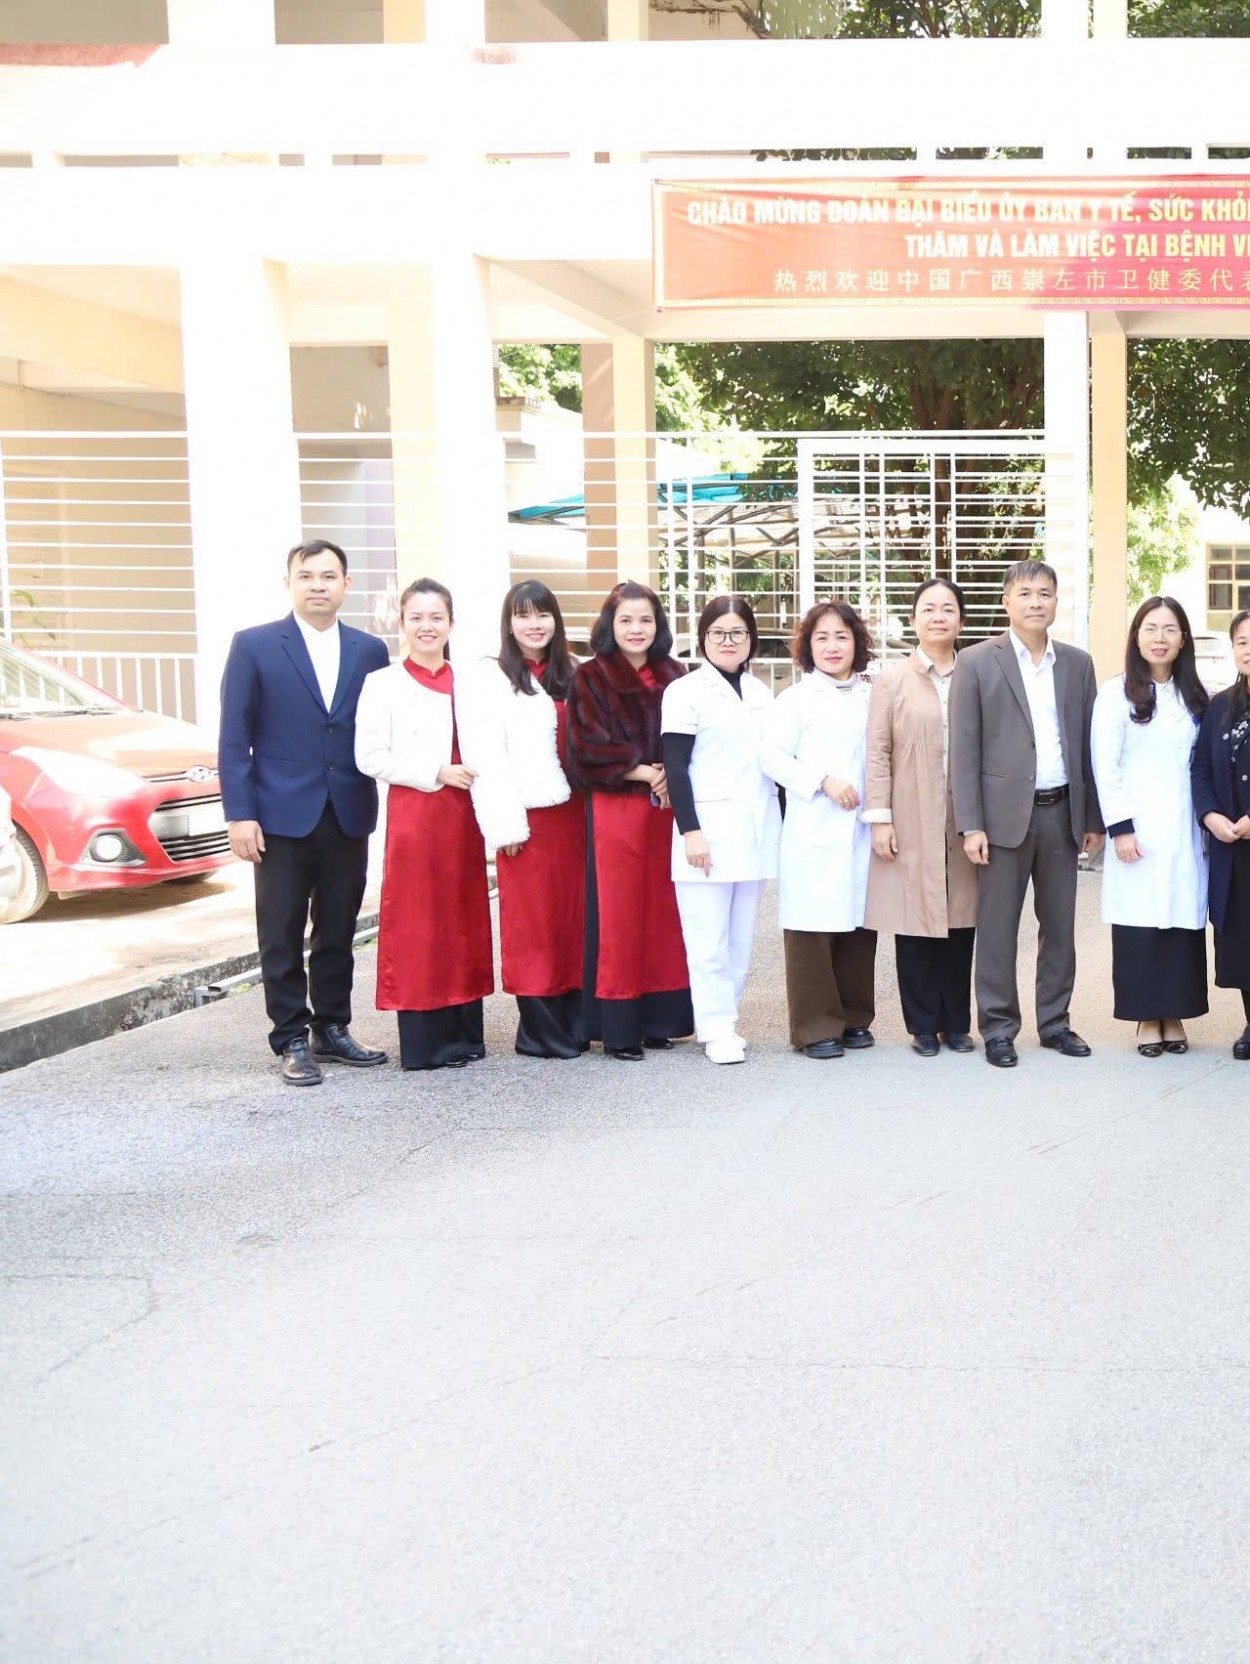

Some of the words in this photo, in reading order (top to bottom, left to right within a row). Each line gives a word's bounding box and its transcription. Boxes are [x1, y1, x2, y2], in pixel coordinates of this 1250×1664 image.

[687, 196, 747, 225] CHÀO
[753, 196, 821, 224] MỪNG
[895, 198, 934, 228] ĐẠI
[940, 189, 992, 223] BIỂU
[999, 191, 1026, 222] ỦY
[1034, 198, 1082, 222] BAN
[1087, 198, 1103, 222] Y
[1108, 190, 1142, 225] TẾ,
[1148, 193, 1195, 222] SỨC
[905, 229, 969, 258] THĂM
[974, 228, 1005, 258] VÀ
[1010, 228, 1059, 258] LÀM
[1065, 229, 1116, 263] VIỆC
[1122, 234, 1158, 263] TẠI
[1164, 229, 1226, 263] BỆNH
